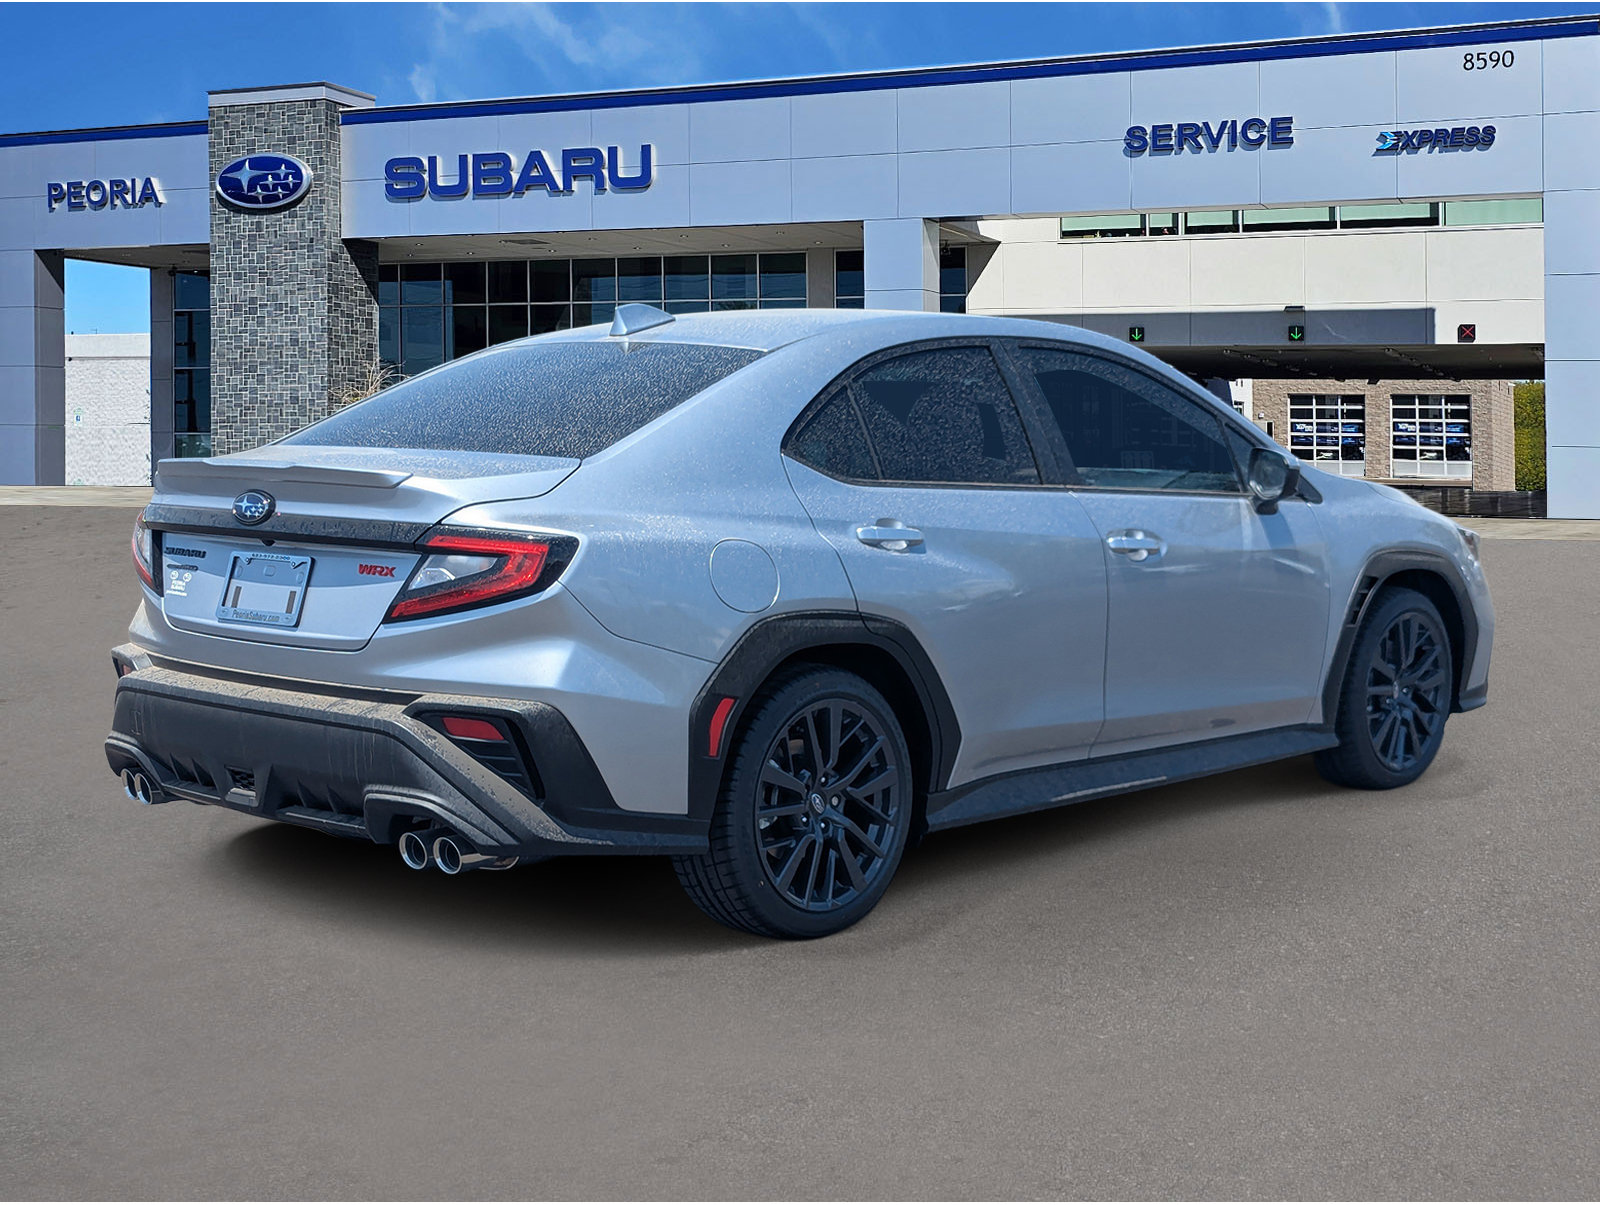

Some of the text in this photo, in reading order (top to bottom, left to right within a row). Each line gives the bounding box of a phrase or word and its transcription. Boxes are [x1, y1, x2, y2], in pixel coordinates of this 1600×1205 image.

[1463, 50, 1515, 71] 8590
[1124, 115, 1294, 154] SERVICE
[1376, 125, 1496, 153] EXPRESS
[384, 143, 654, 201] SUBARU
[47, 176, 162, 210] PEORIA
[358, 562, 396, 578] WRX
